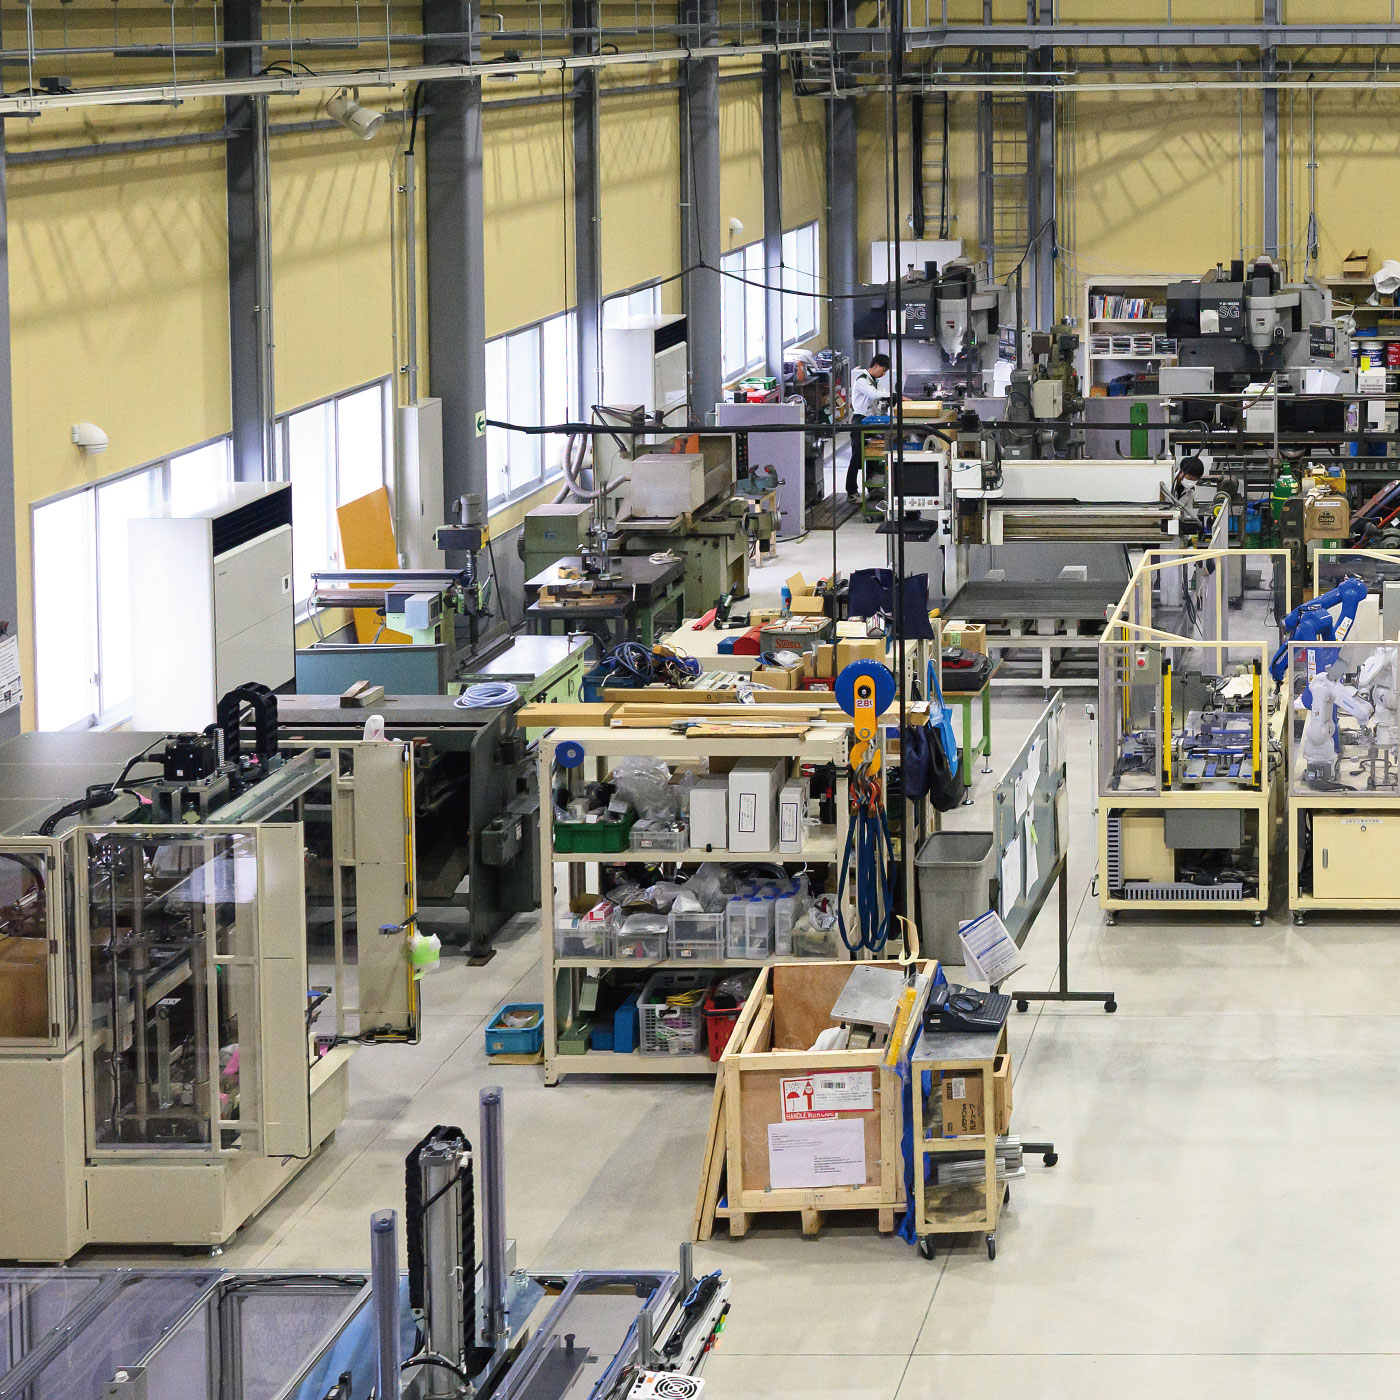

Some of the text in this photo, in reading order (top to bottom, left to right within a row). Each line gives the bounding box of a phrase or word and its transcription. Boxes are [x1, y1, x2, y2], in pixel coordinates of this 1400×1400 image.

[905, 307, 926, 319] SG
[1219, 305, 1240, 318] SG
[785, 1111, 808, 1120] HANDLE
